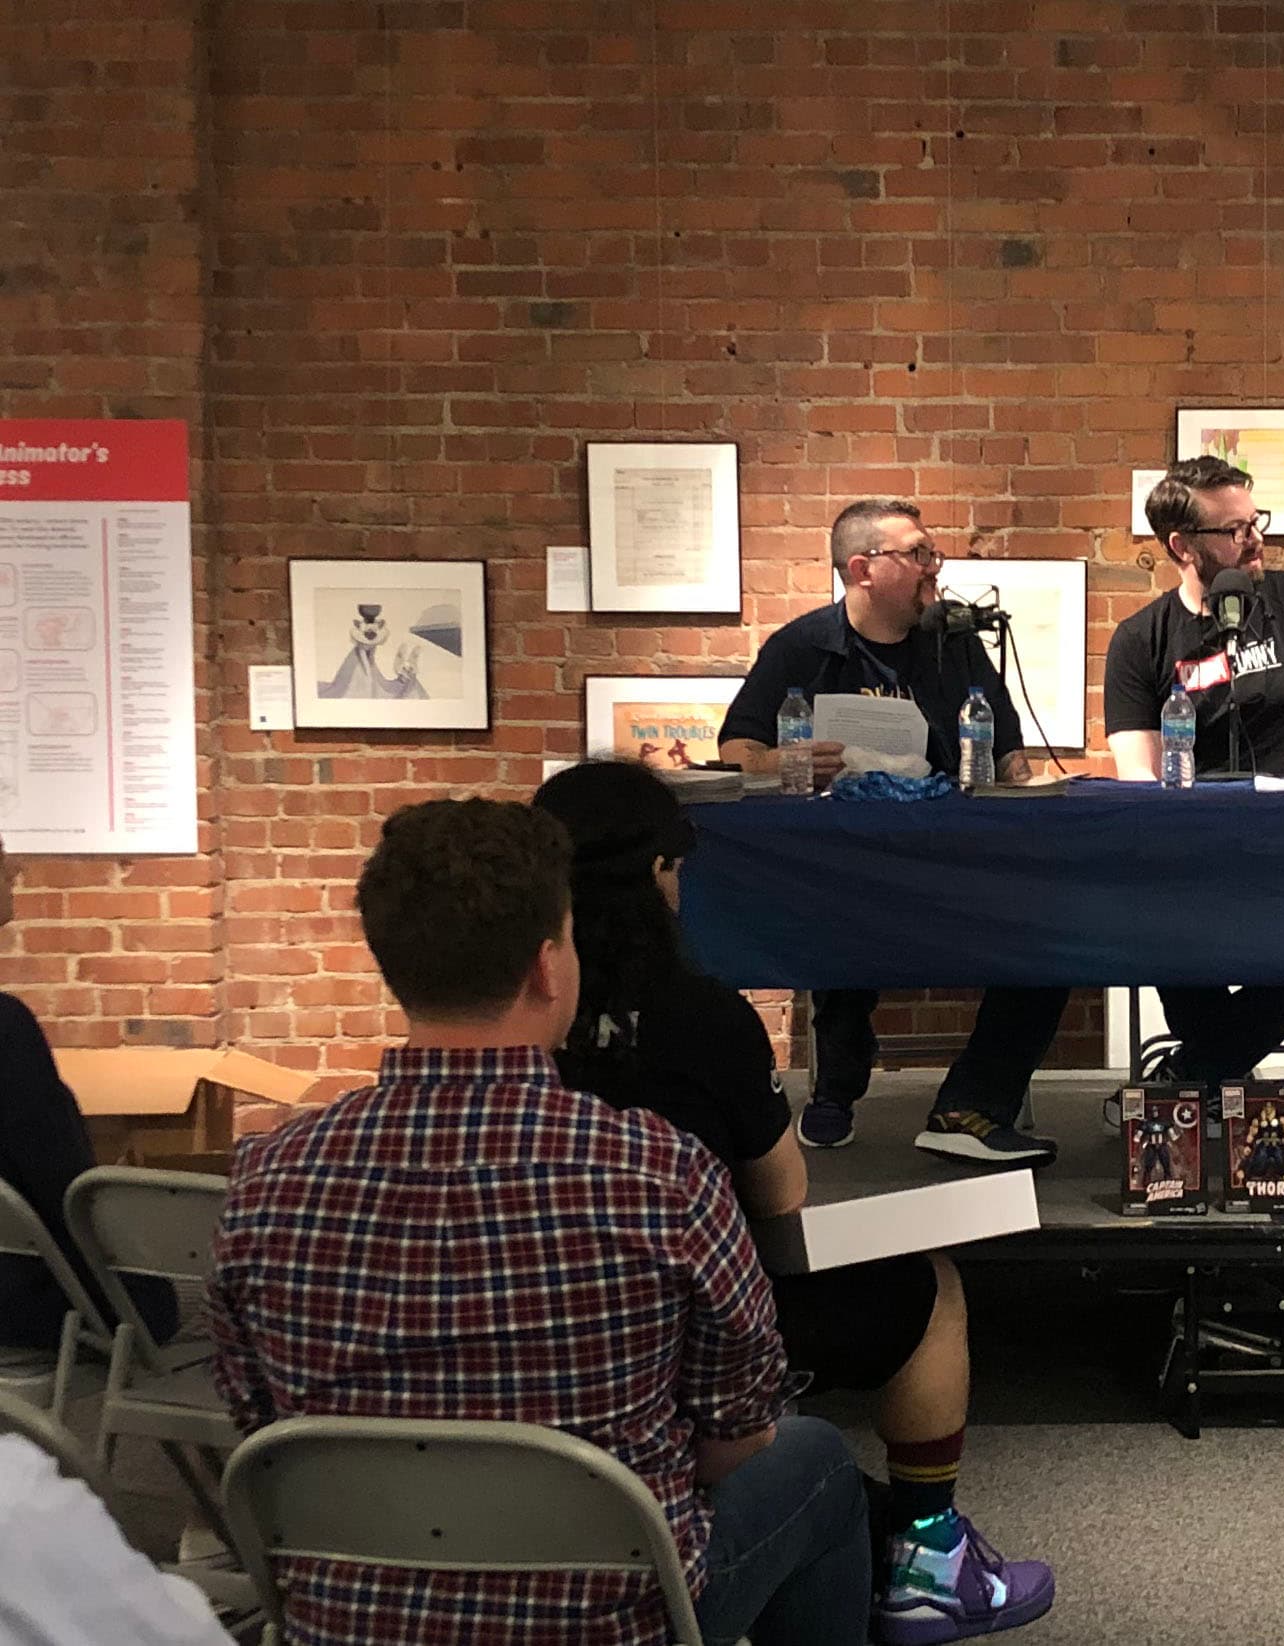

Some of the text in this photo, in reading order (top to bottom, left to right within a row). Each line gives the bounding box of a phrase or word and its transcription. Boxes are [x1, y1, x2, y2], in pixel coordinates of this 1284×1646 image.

[0, 441, 110, 462] nimator's
[631, 724, 716, 740] TWIN TROUBLES
